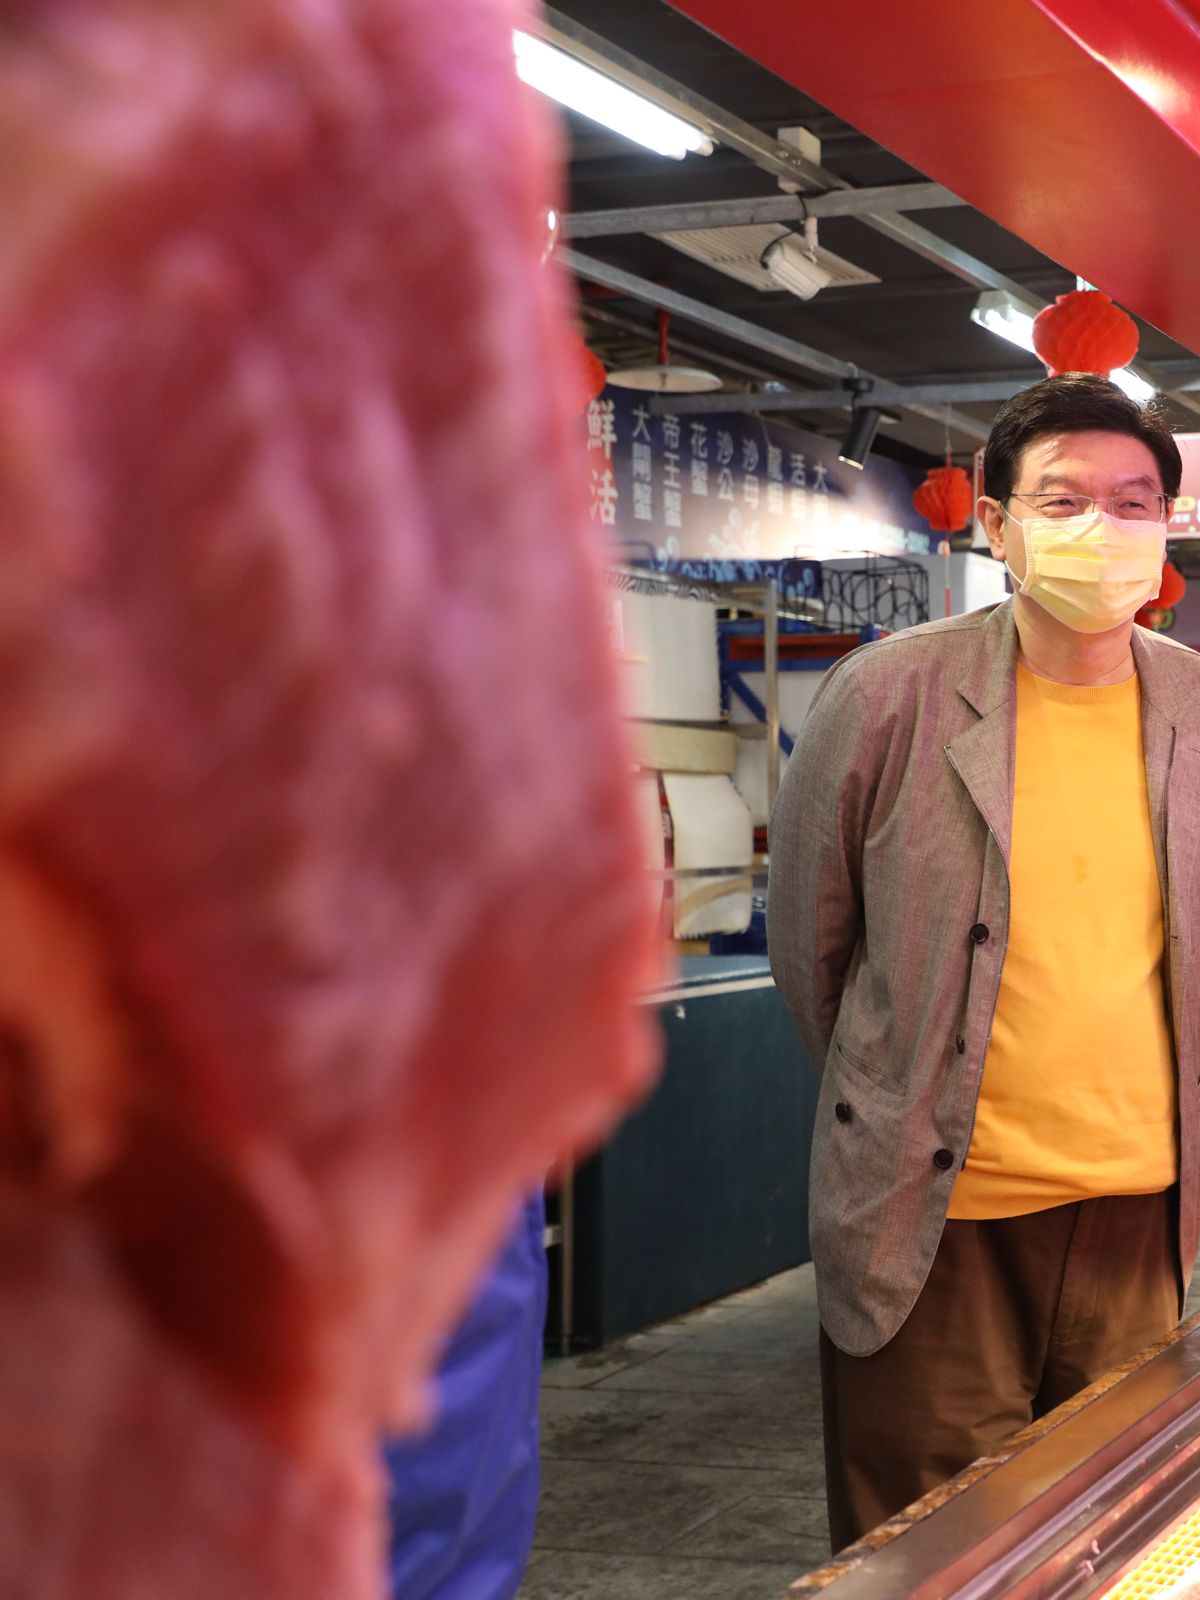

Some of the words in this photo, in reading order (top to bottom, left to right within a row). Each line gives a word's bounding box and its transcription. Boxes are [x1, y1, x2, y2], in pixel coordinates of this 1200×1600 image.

[587, 399, 618, 526] 鮮活
[662, 413, 682, 528] 帝王蟹
